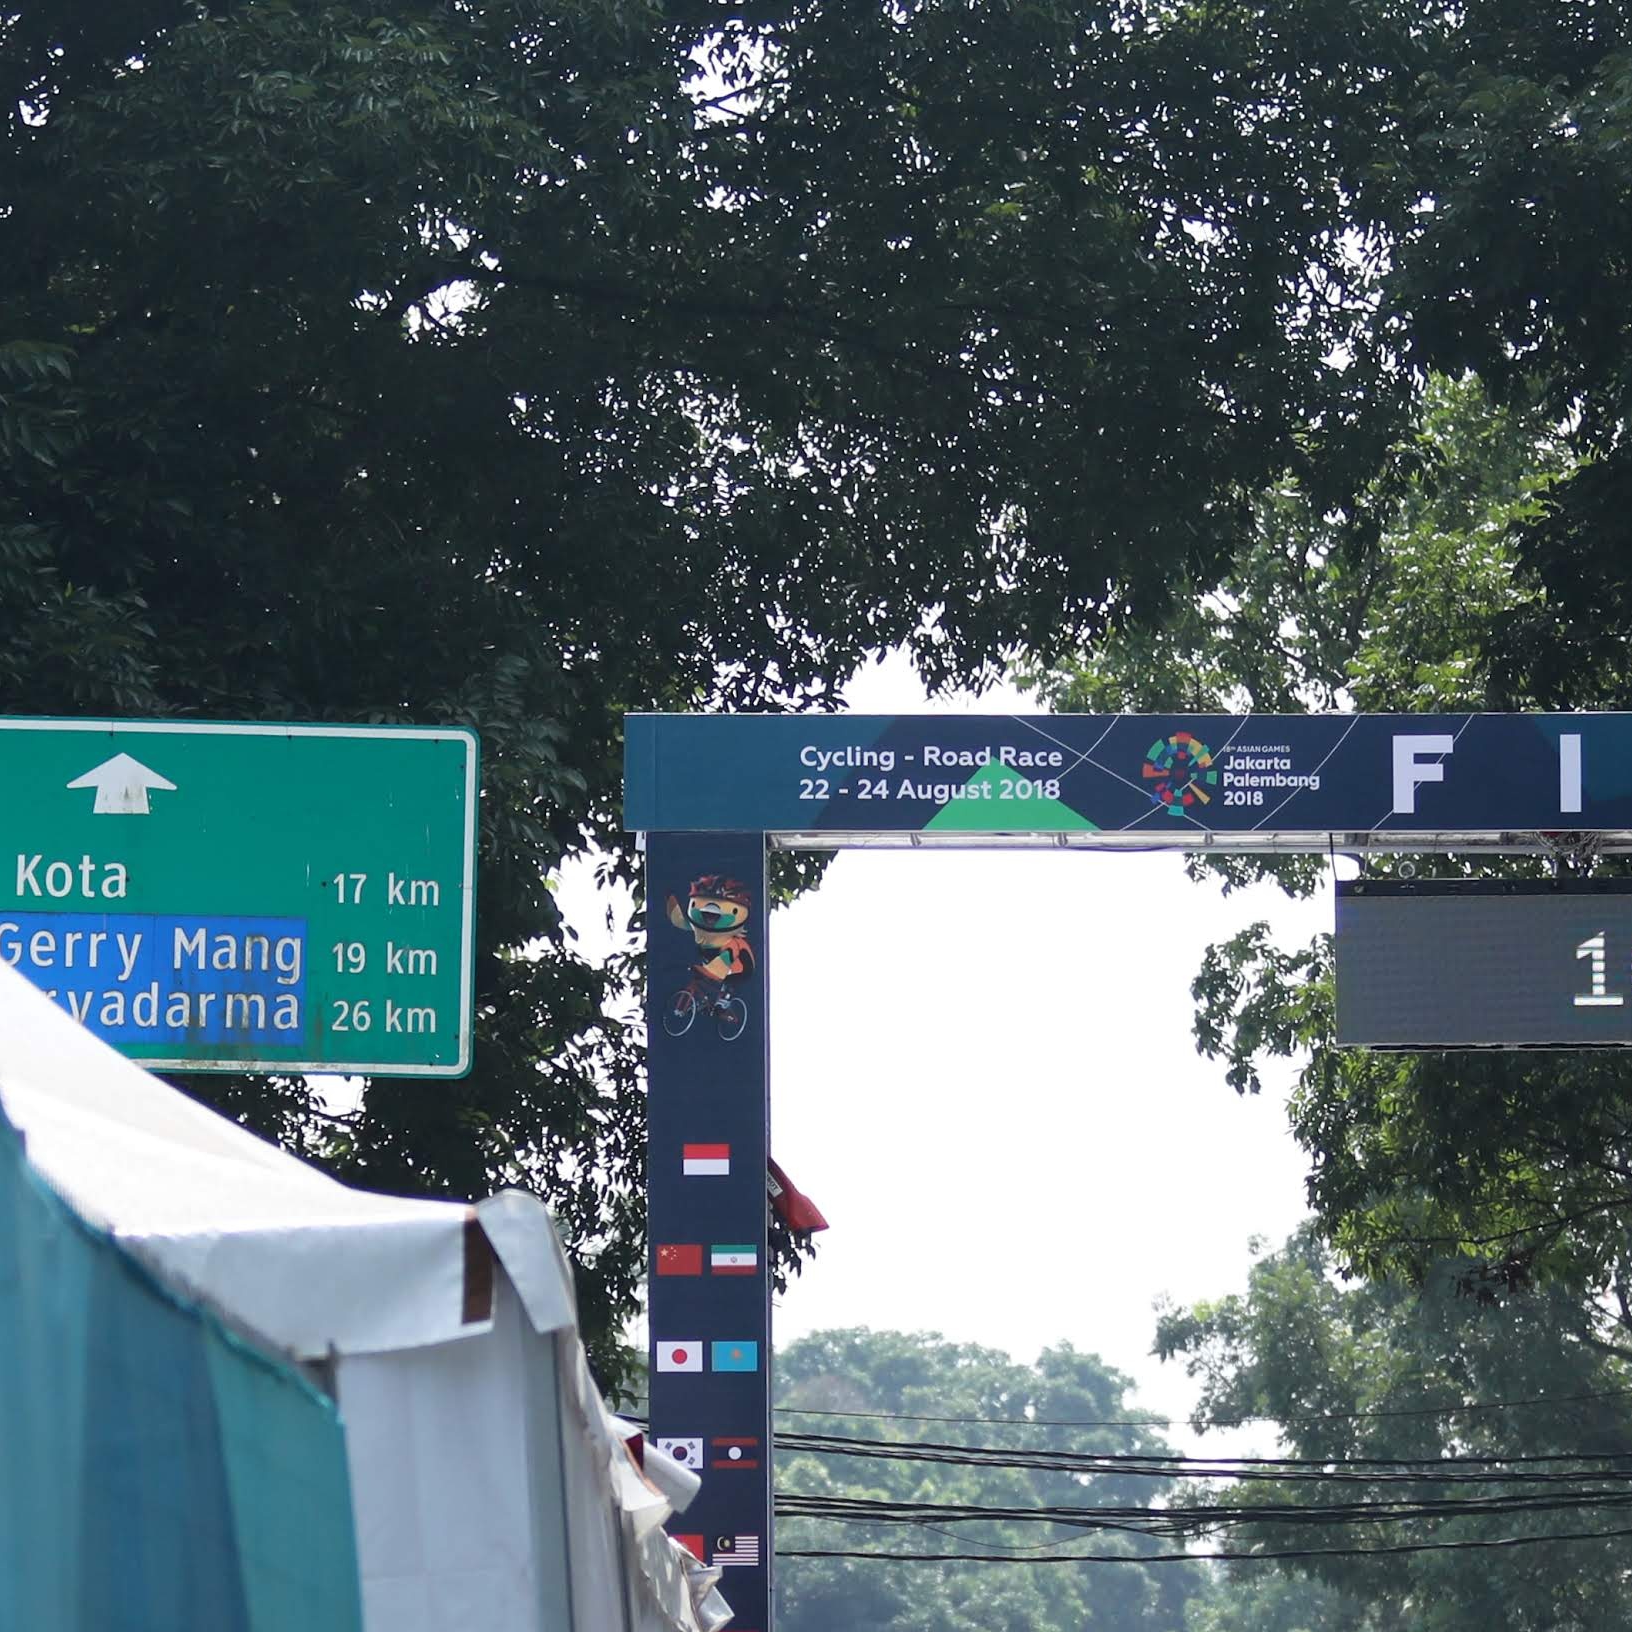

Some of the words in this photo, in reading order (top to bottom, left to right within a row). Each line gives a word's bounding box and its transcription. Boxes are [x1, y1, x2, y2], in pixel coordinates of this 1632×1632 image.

[799, 746, 895, 771] Cycling
[923, 746, 991, 766] Road
[999, 746, 1063, 767] Race
[1236, 745, 1261, 753] ASIAN
[1261, 745, 1291, 753] GAMES
[1224, 755, 1291, 770] Jakarta
[798, 778, 830, 800] 22
[857, 778, 889, 800] 24
[896, 778, 992, 804] August
[998, 778, 1061, 800] 2018
[1223, 772, 1320, 790] Palembang
[1223, 791, 1264, 806] 2018
[16, 853, 128, 898] Kota
[332, 873, 368, 904] 17
[388, 872, 440, 906] km
[173, 927, 302, 985] Mang
[332, 942, 367, 974] 19
[386, 941, 438, 975] km
[331, 1000, 372, 1032] 26
[385, 1000, 436, 1033] km
